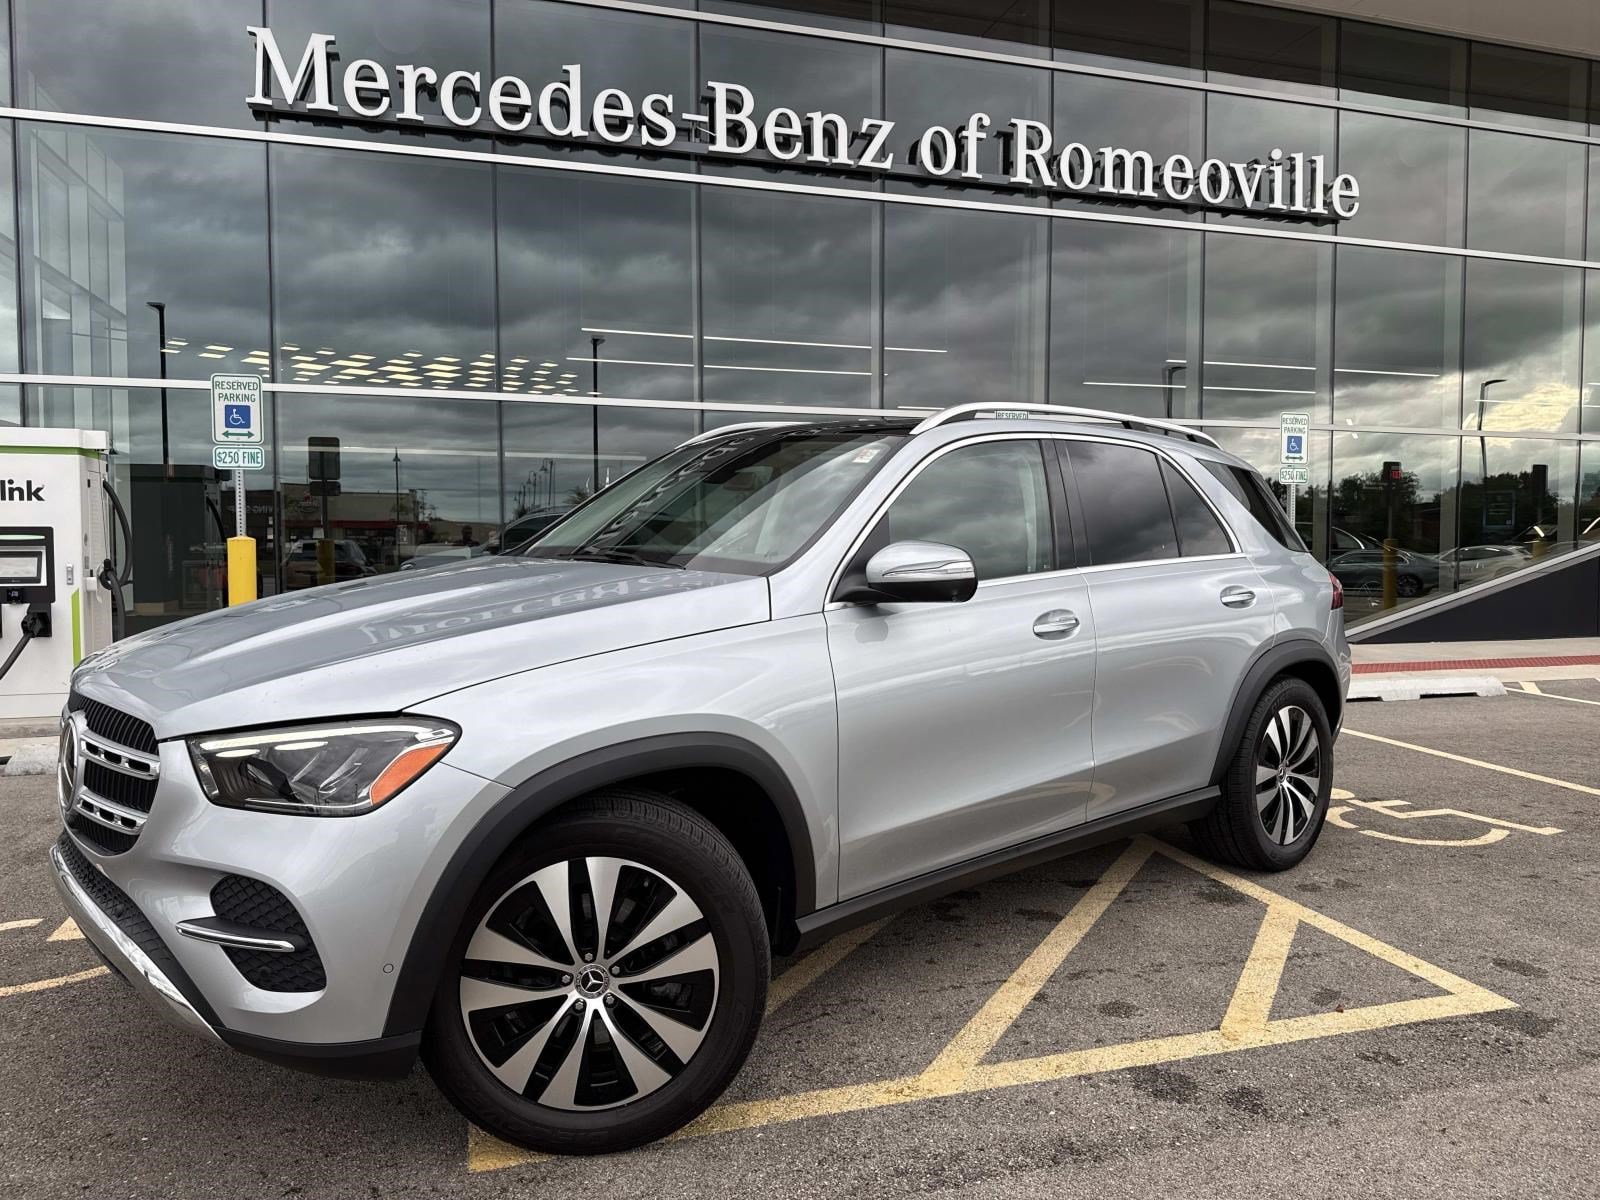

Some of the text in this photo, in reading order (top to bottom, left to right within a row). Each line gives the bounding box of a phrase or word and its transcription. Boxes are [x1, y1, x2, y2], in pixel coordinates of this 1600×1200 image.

[245, 25, 1361, 219] Mercedes-Benz of Romeoville
[214, 380, 259, 391] RESERVED
[218, 392, 256, 403] PARKING
[1282, 417, 1307, 425] RESERVED
[1284, 426, 1306, 434] PARKING
[216, 450, 261, 465] $250 FINE
[1281, 470, 1307, 481] $250 FINE
[0, 479, 46, 502] link
